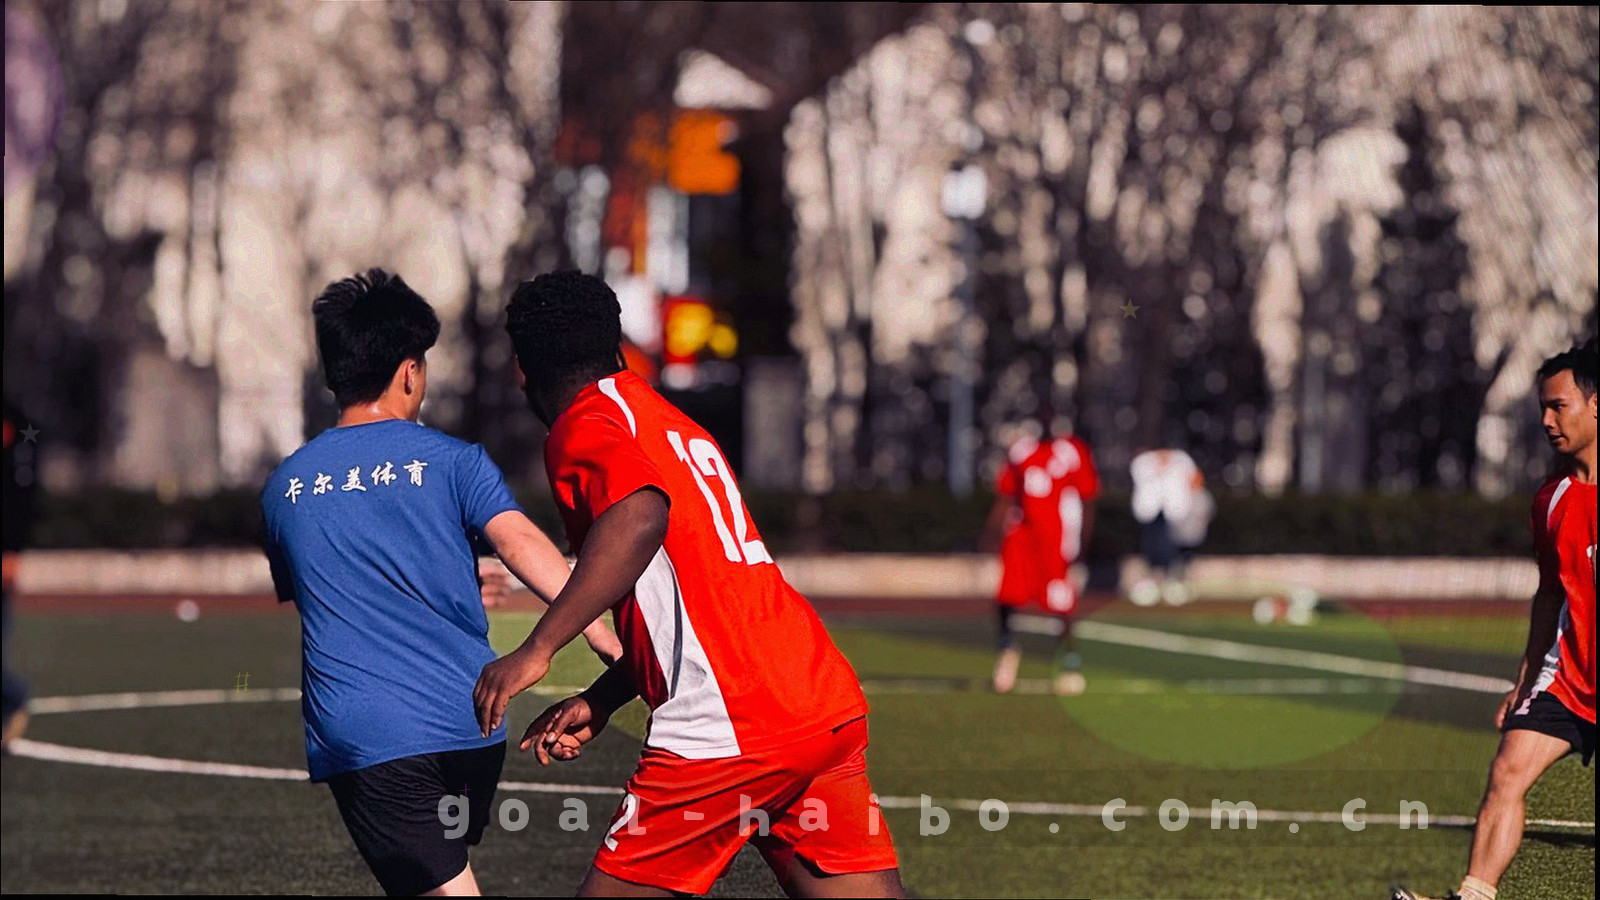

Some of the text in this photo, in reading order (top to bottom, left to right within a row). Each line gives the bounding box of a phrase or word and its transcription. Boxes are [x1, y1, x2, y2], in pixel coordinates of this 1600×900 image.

[284, 459, 428, 504] 卡尔美体育
[665, 430, 774, 565] 12
